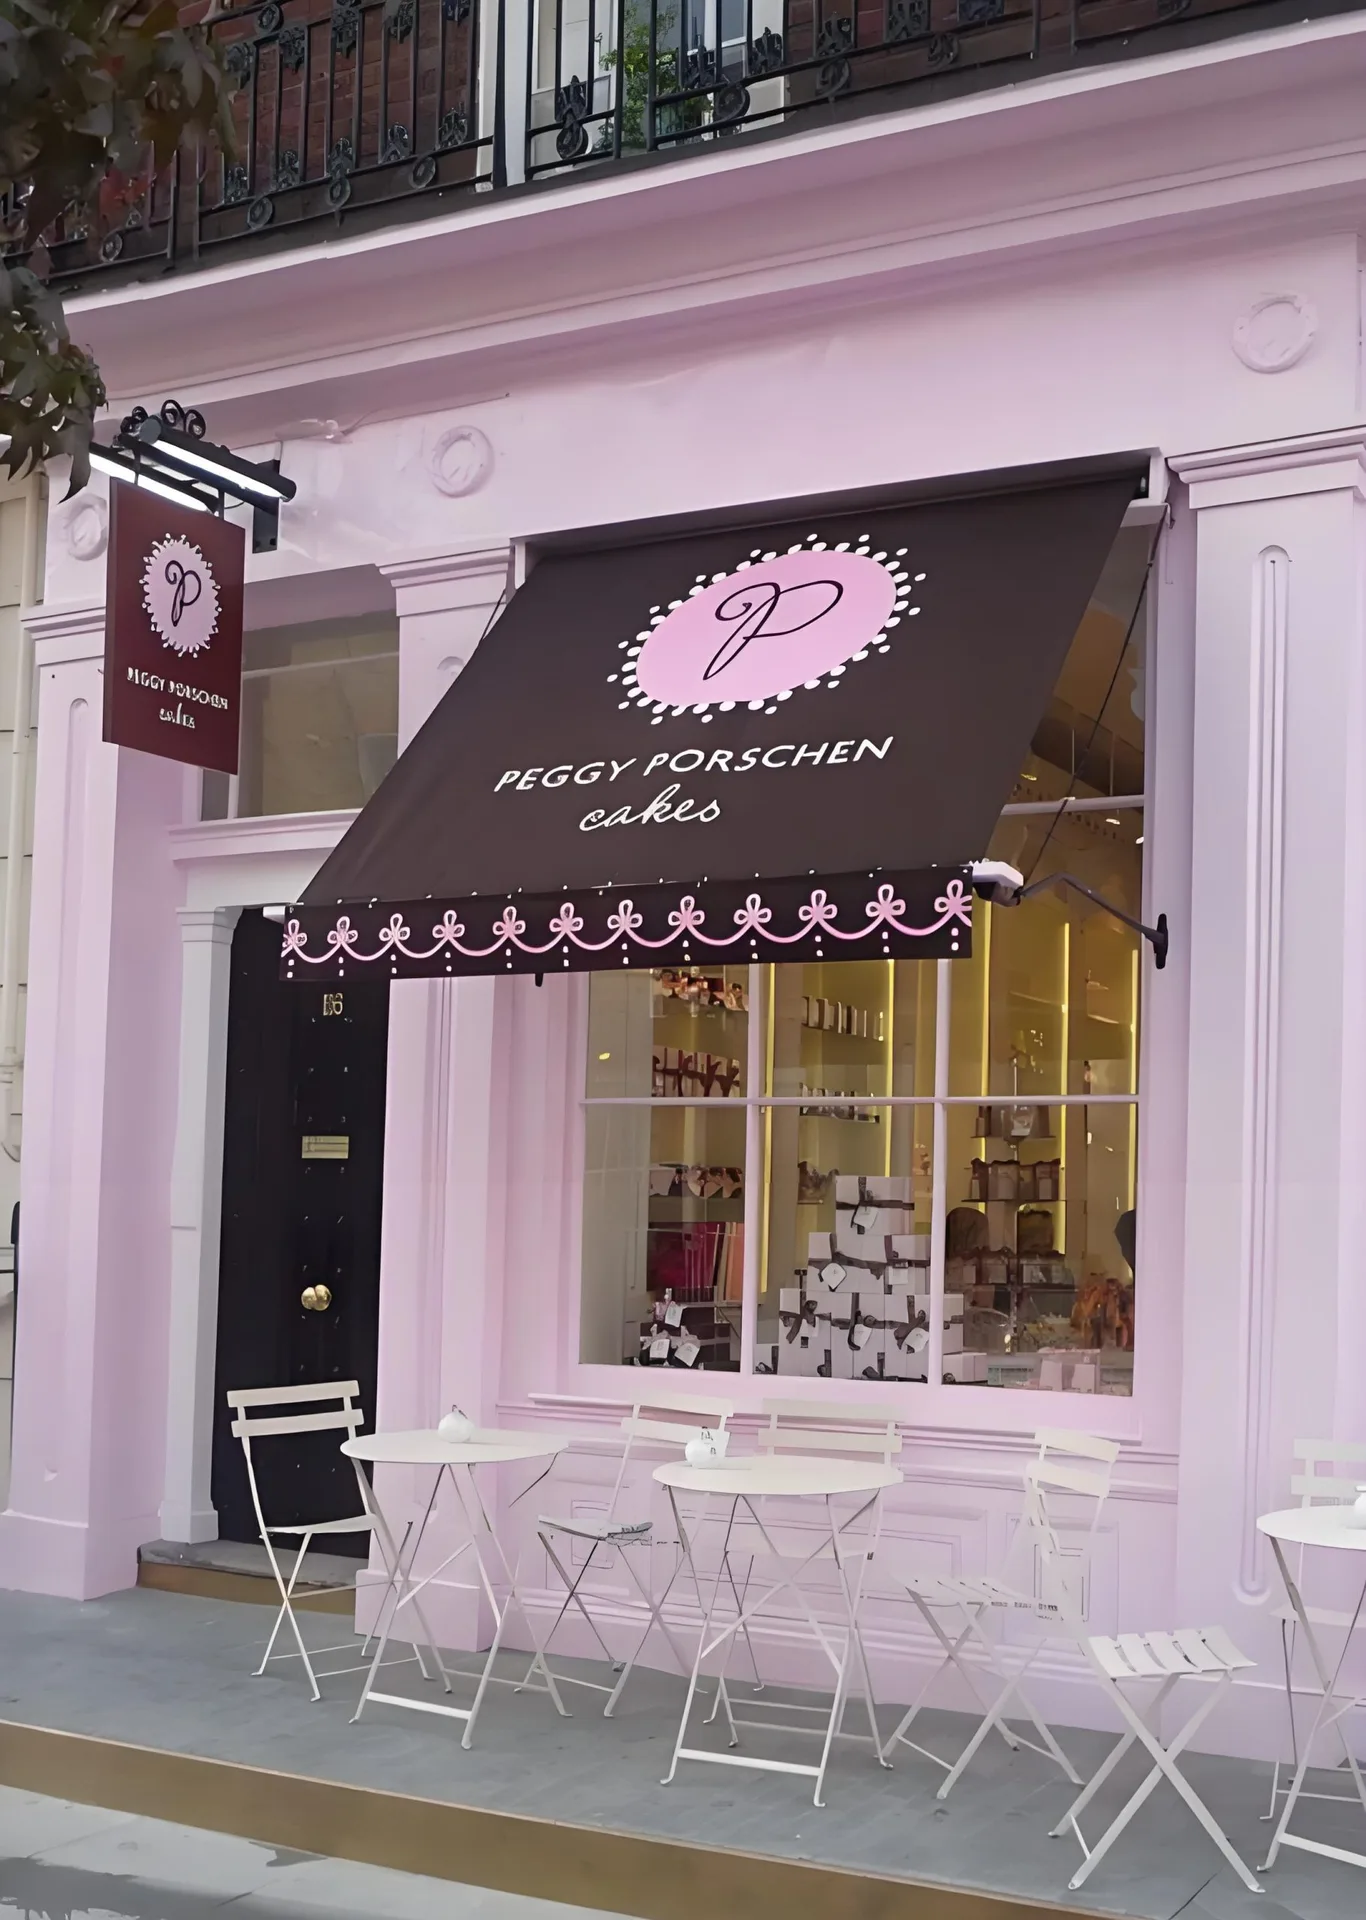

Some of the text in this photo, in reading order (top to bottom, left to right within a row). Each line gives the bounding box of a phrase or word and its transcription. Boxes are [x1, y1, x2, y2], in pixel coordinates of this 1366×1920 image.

[494, 735, 894, 793] PEGGY PORSCHEN
[579, 783, 721, 832] cakes
